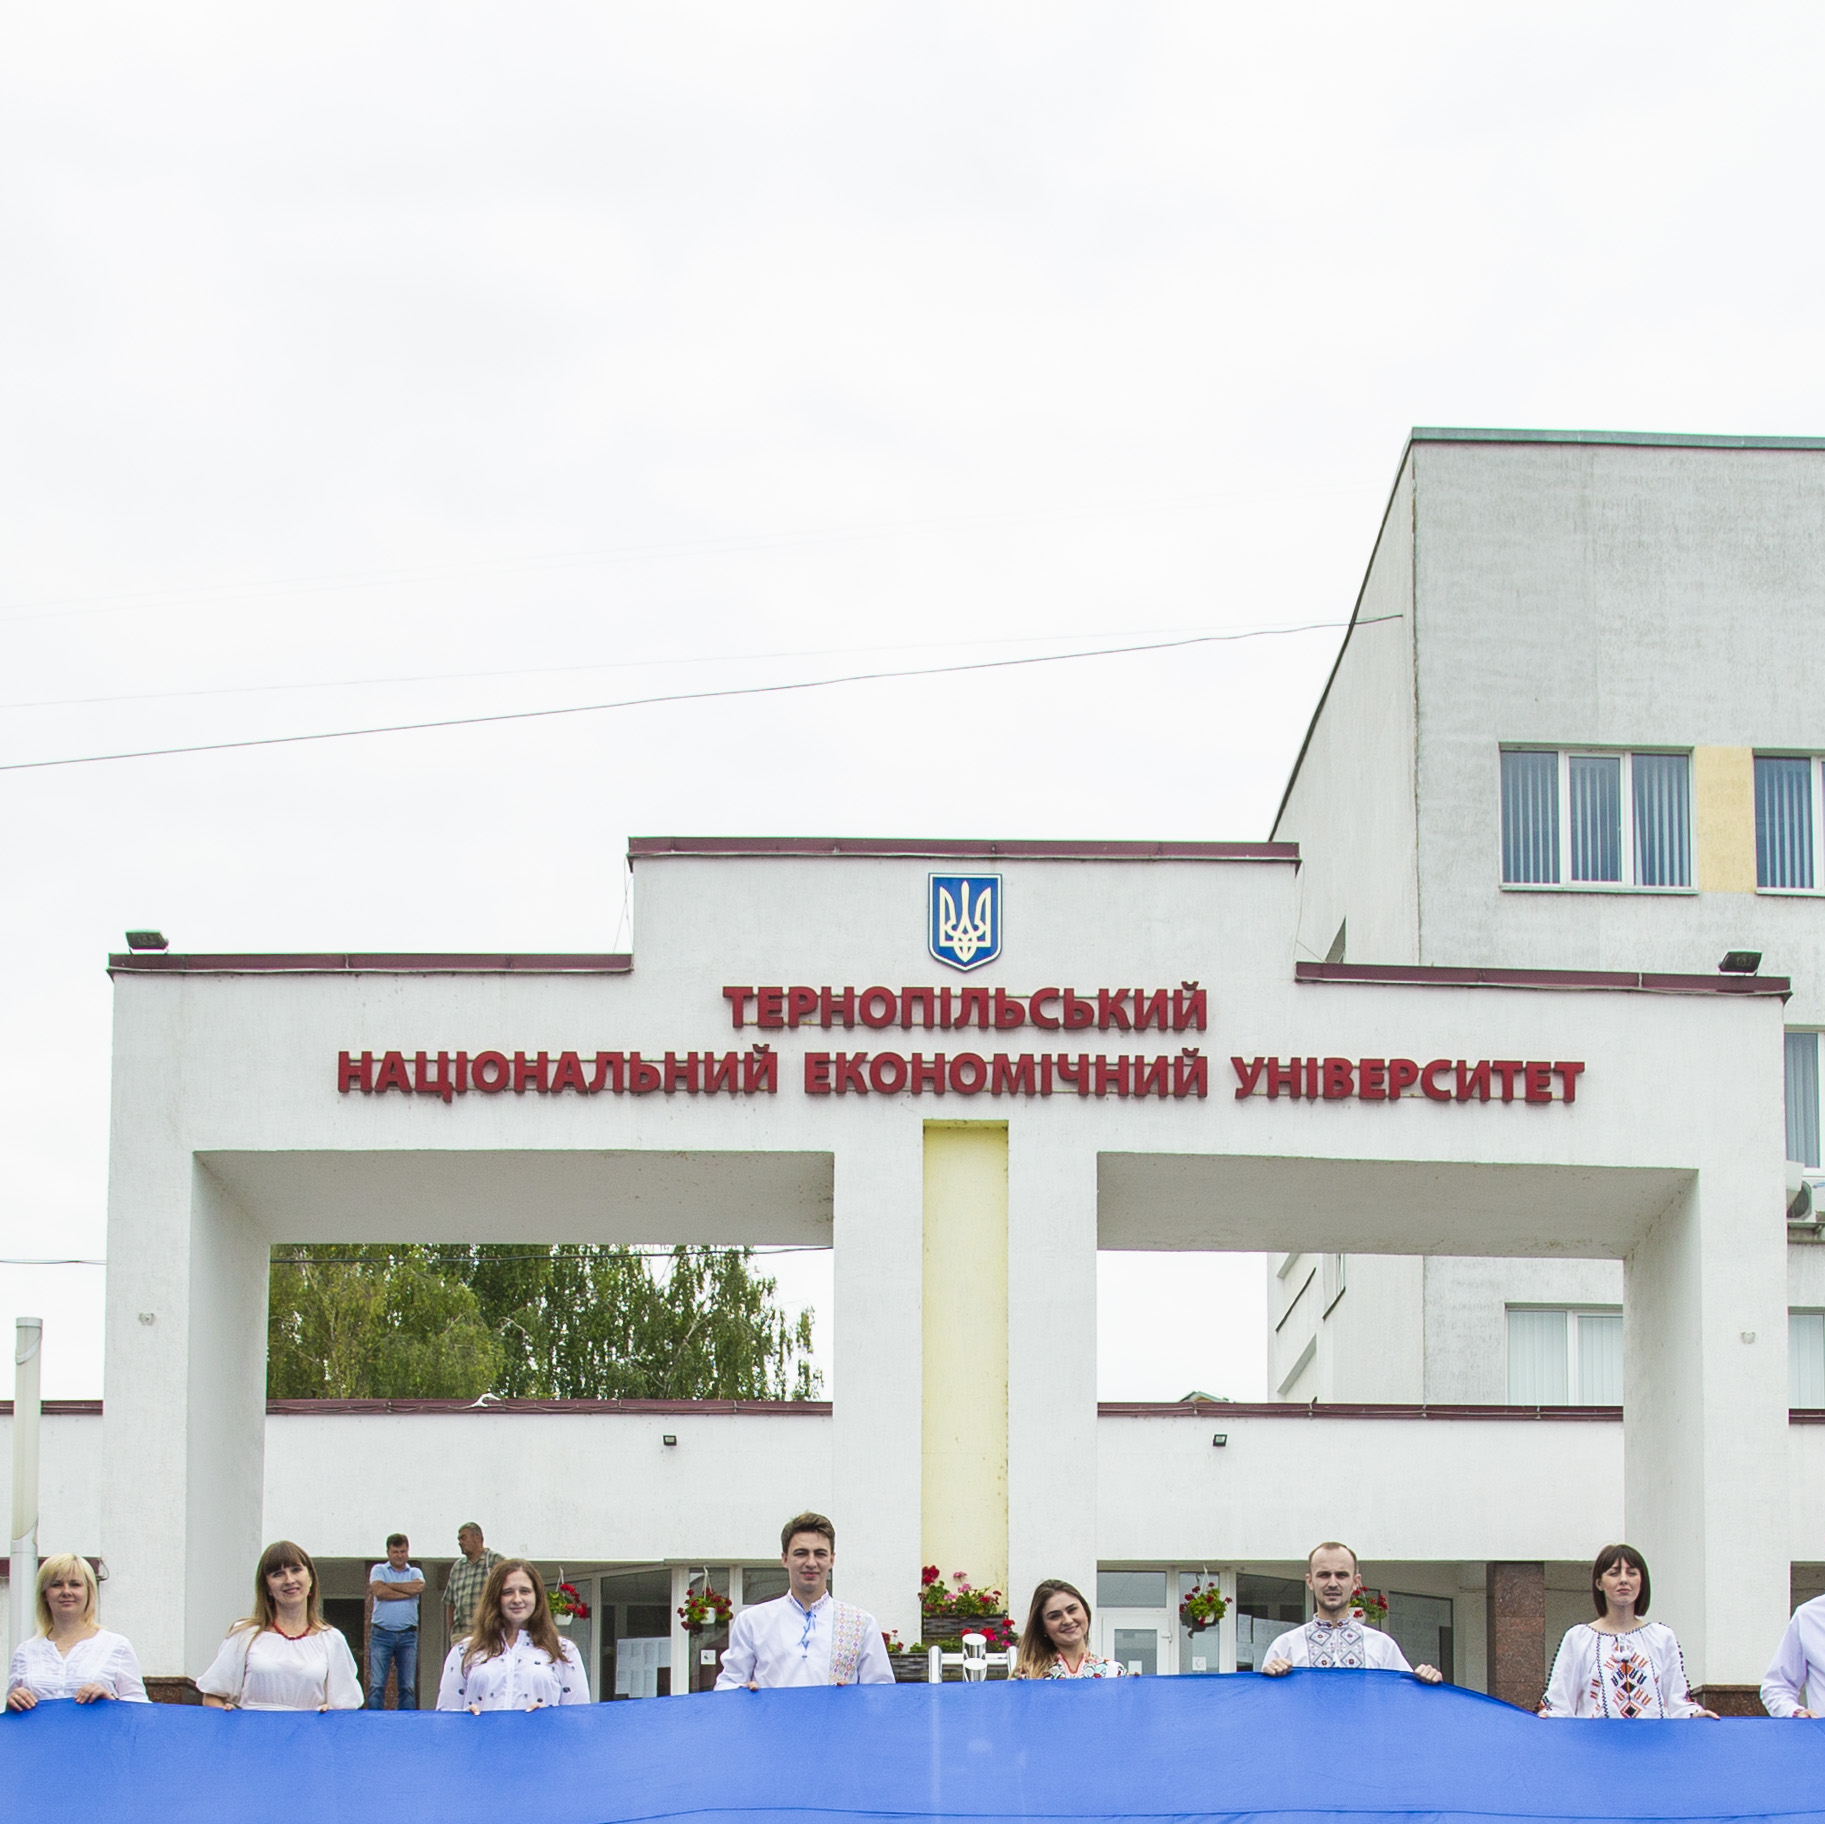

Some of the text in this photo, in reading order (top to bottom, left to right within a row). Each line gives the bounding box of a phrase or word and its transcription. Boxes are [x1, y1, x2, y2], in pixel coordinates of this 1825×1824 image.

[722, 981, 1208, 1031] ТЕРНОПІЛЬСЬКИЙ
[337, 1043, 1586, 1104] НАЦІОНАЛЬНИЙ ЕКОНОМІЧНИЙ УНІВЕРСИТЕТ
